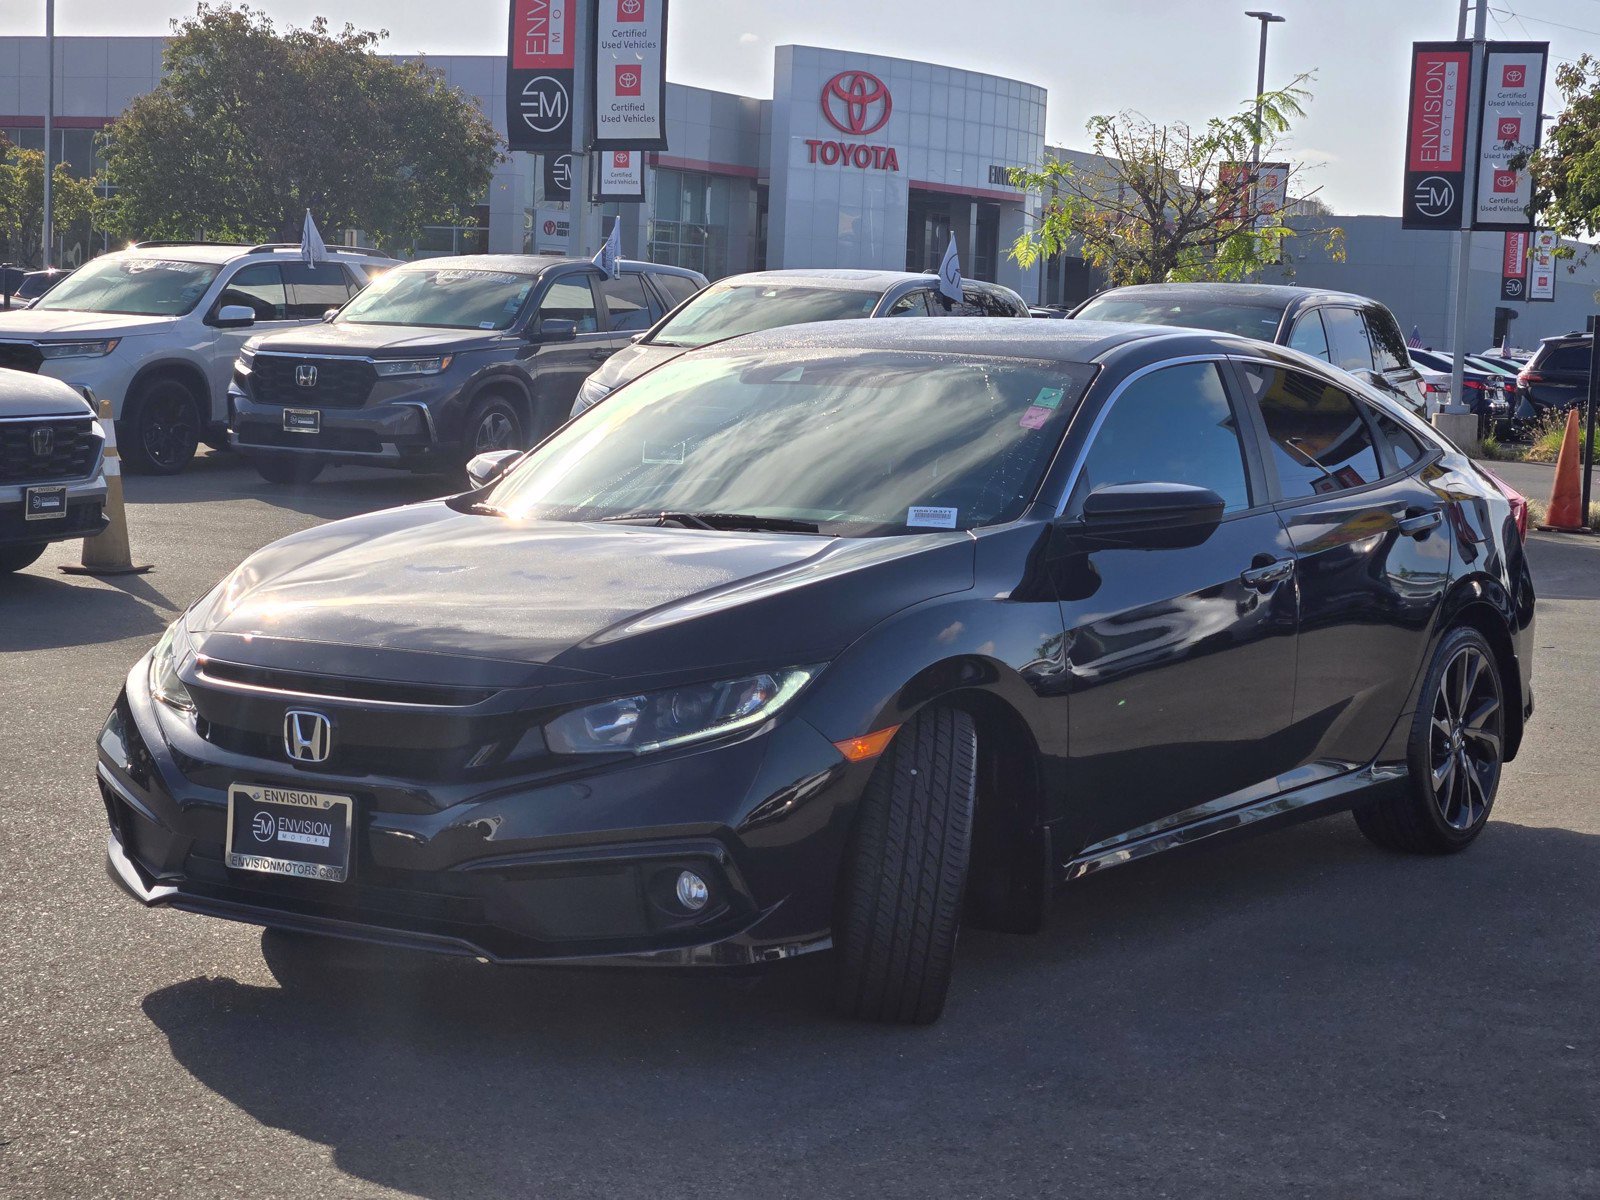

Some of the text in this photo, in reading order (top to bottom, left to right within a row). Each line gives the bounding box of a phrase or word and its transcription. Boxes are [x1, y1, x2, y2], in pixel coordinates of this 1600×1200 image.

[611, 29, 647, 38] Certified
[601, 41, 656, 49] Used Vehicles
[610, 102, 645, 112] Certified
[1421, 62, 1445, 162] ENVISION
[1442, 70, 1455, 153] MOTORS
[601, 115, 656, 123] Used Vehicles
[806, 139, 899, 171] TOYOTA
[264, 790, 318, 806] ENVISION
[278, 817, 332, 836] ENVISION
[231, 856, 341, 879] ENVISIONMOTORS.COM
